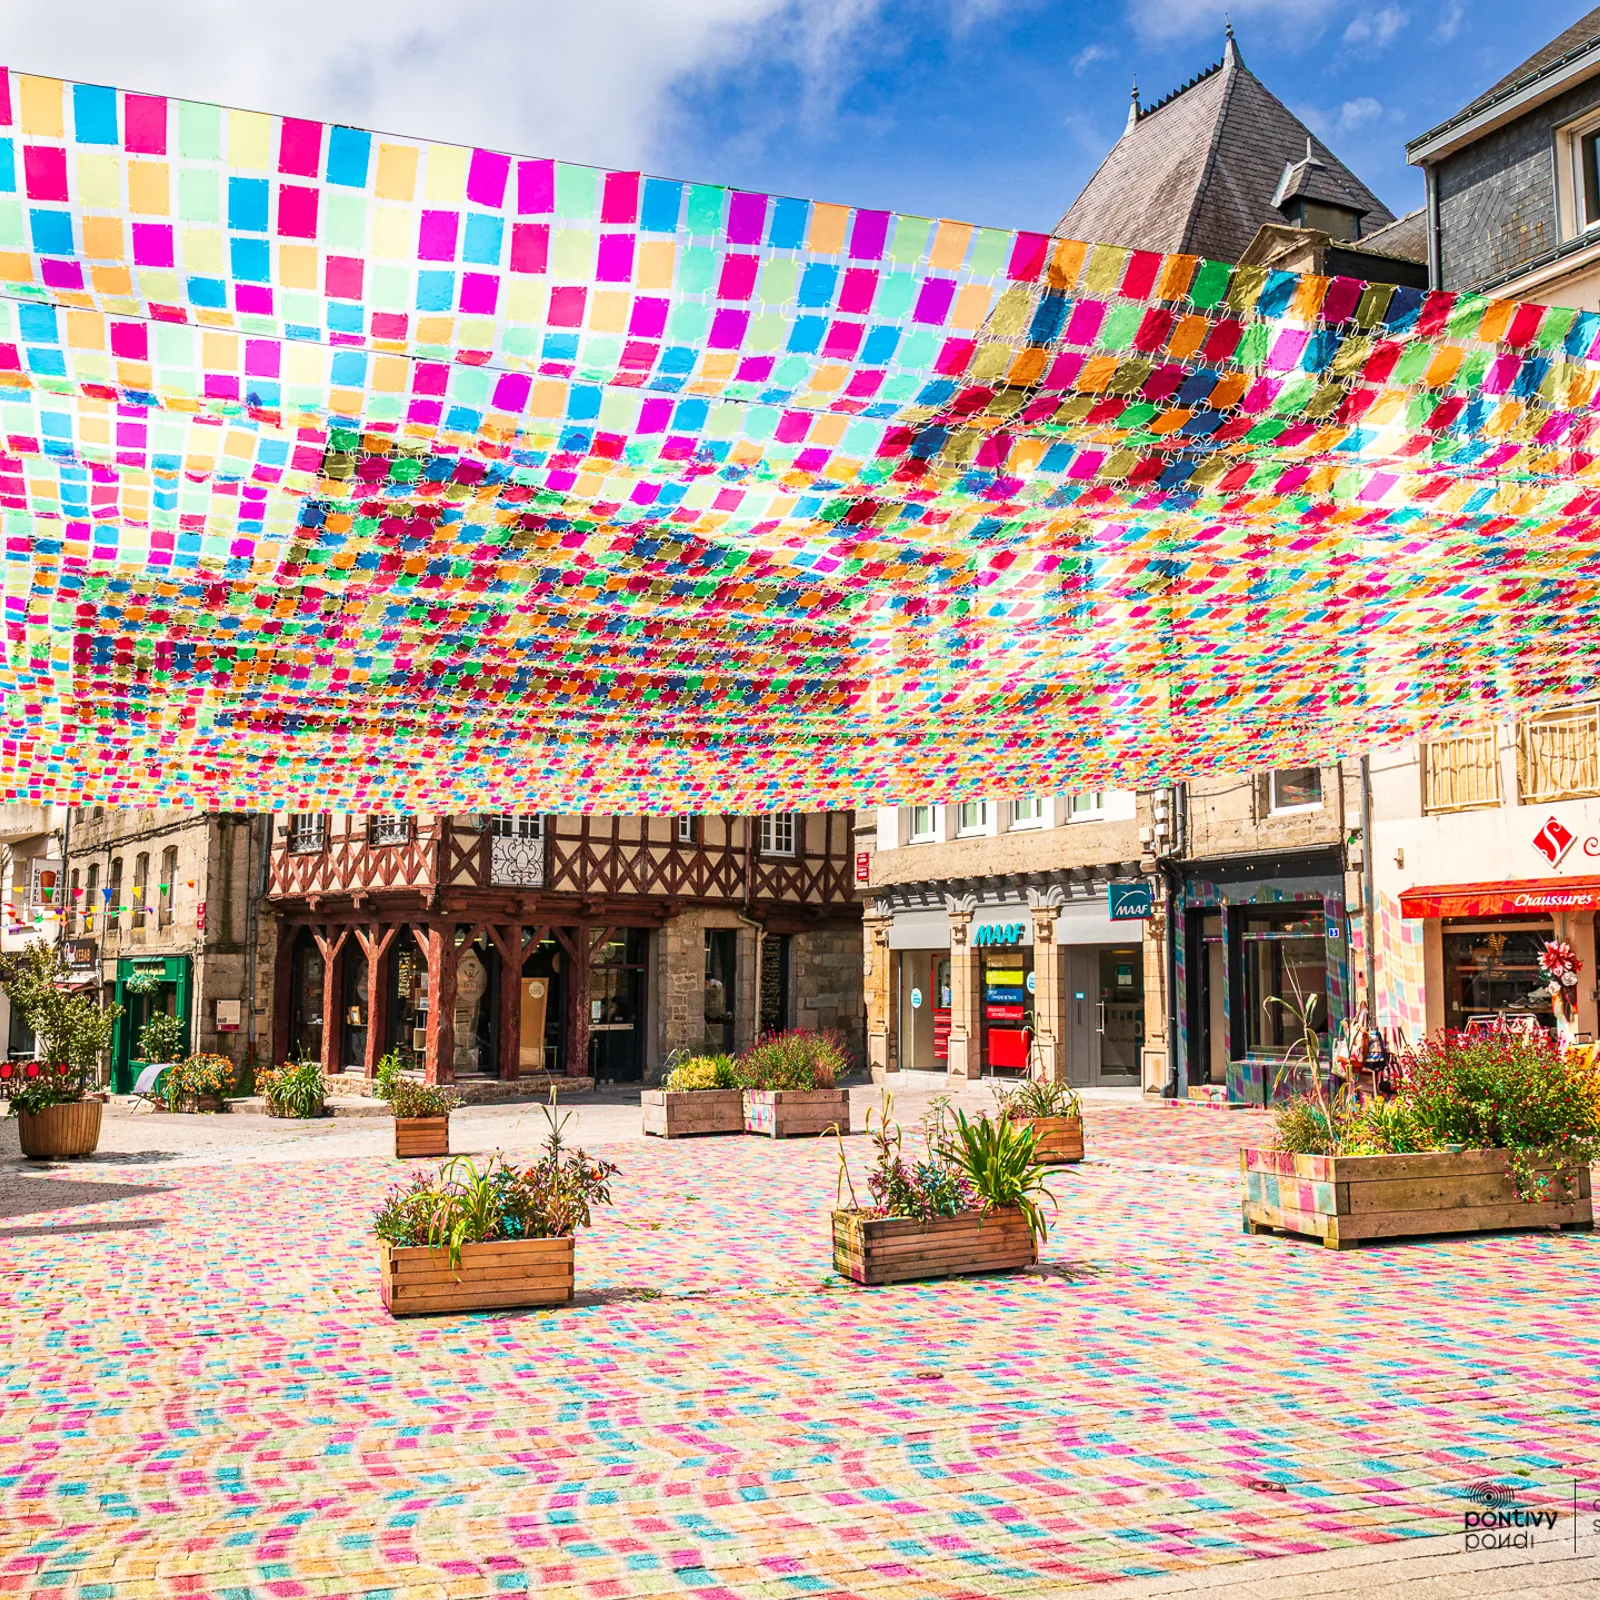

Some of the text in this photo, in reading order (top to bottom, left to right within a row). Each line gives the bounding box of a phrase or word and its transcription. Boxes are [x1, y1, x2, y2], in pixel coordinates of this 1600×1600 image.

[1514, 894, 1593, 907] Chaussures
[1115, 904, 1148, 916] MAAF
[974, 923, 1023, 945] MAAF
